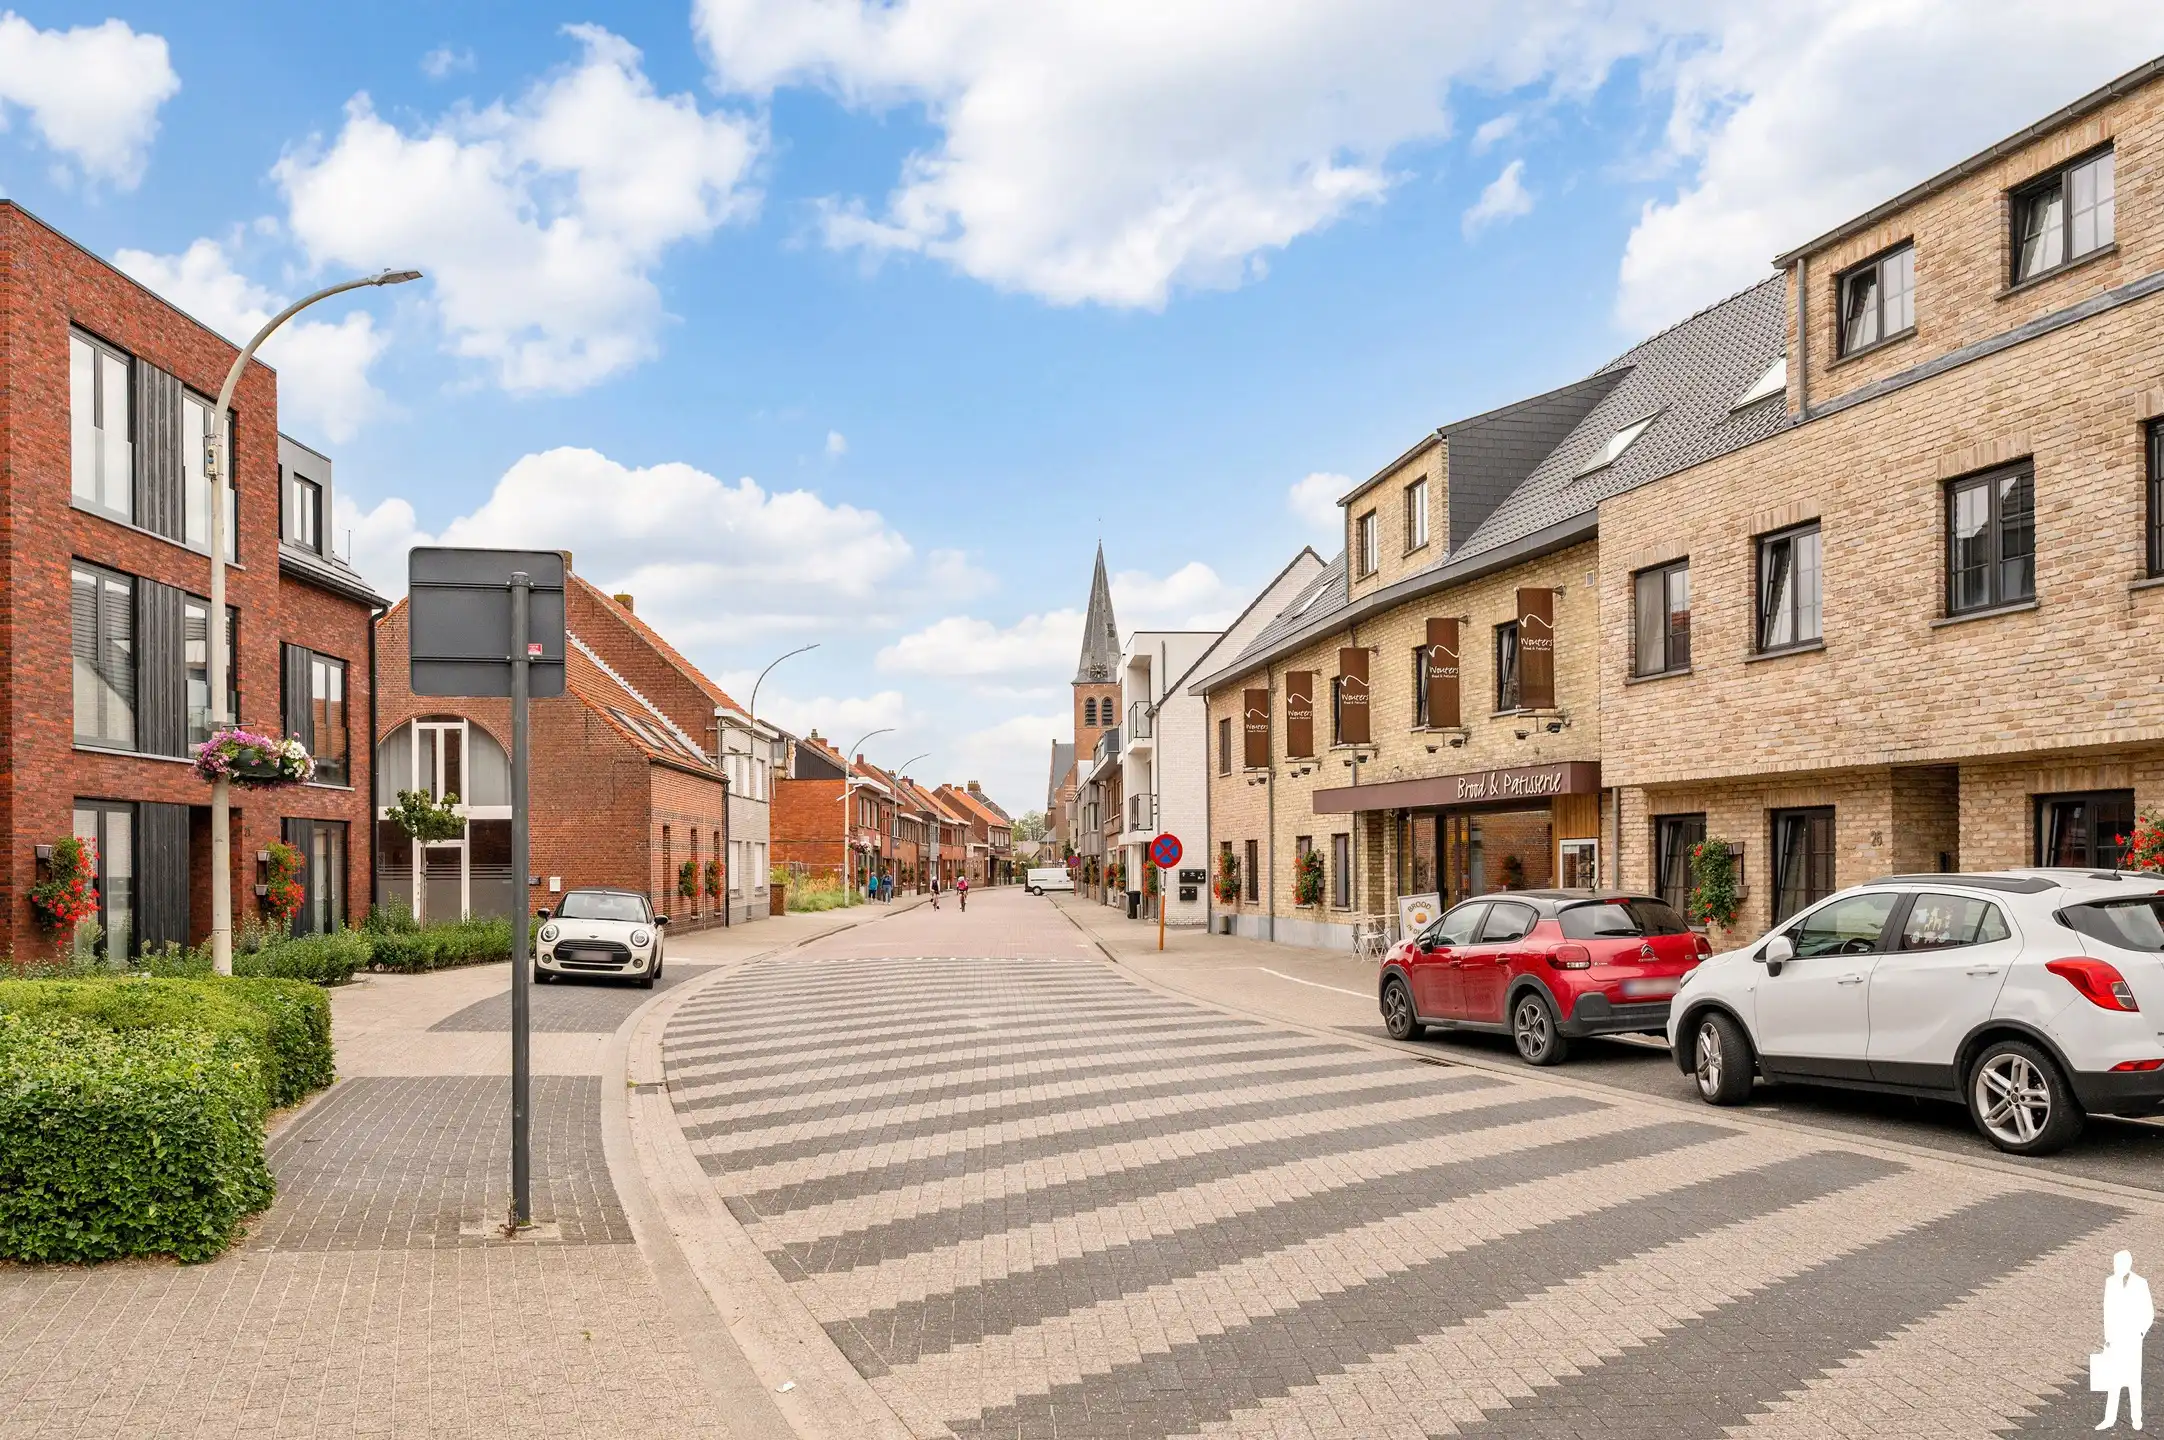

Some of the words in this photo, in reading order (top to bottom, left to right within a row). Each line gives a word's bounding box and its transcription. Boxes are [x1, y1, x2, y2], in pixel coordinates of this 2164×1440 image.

[1457, 773, 1486, 799] Brood
[1489, 772, 1499, 796] &
[1503, 772, 1562, 795] Patisserie
[1407, 901, 1432, 912] BROOD
